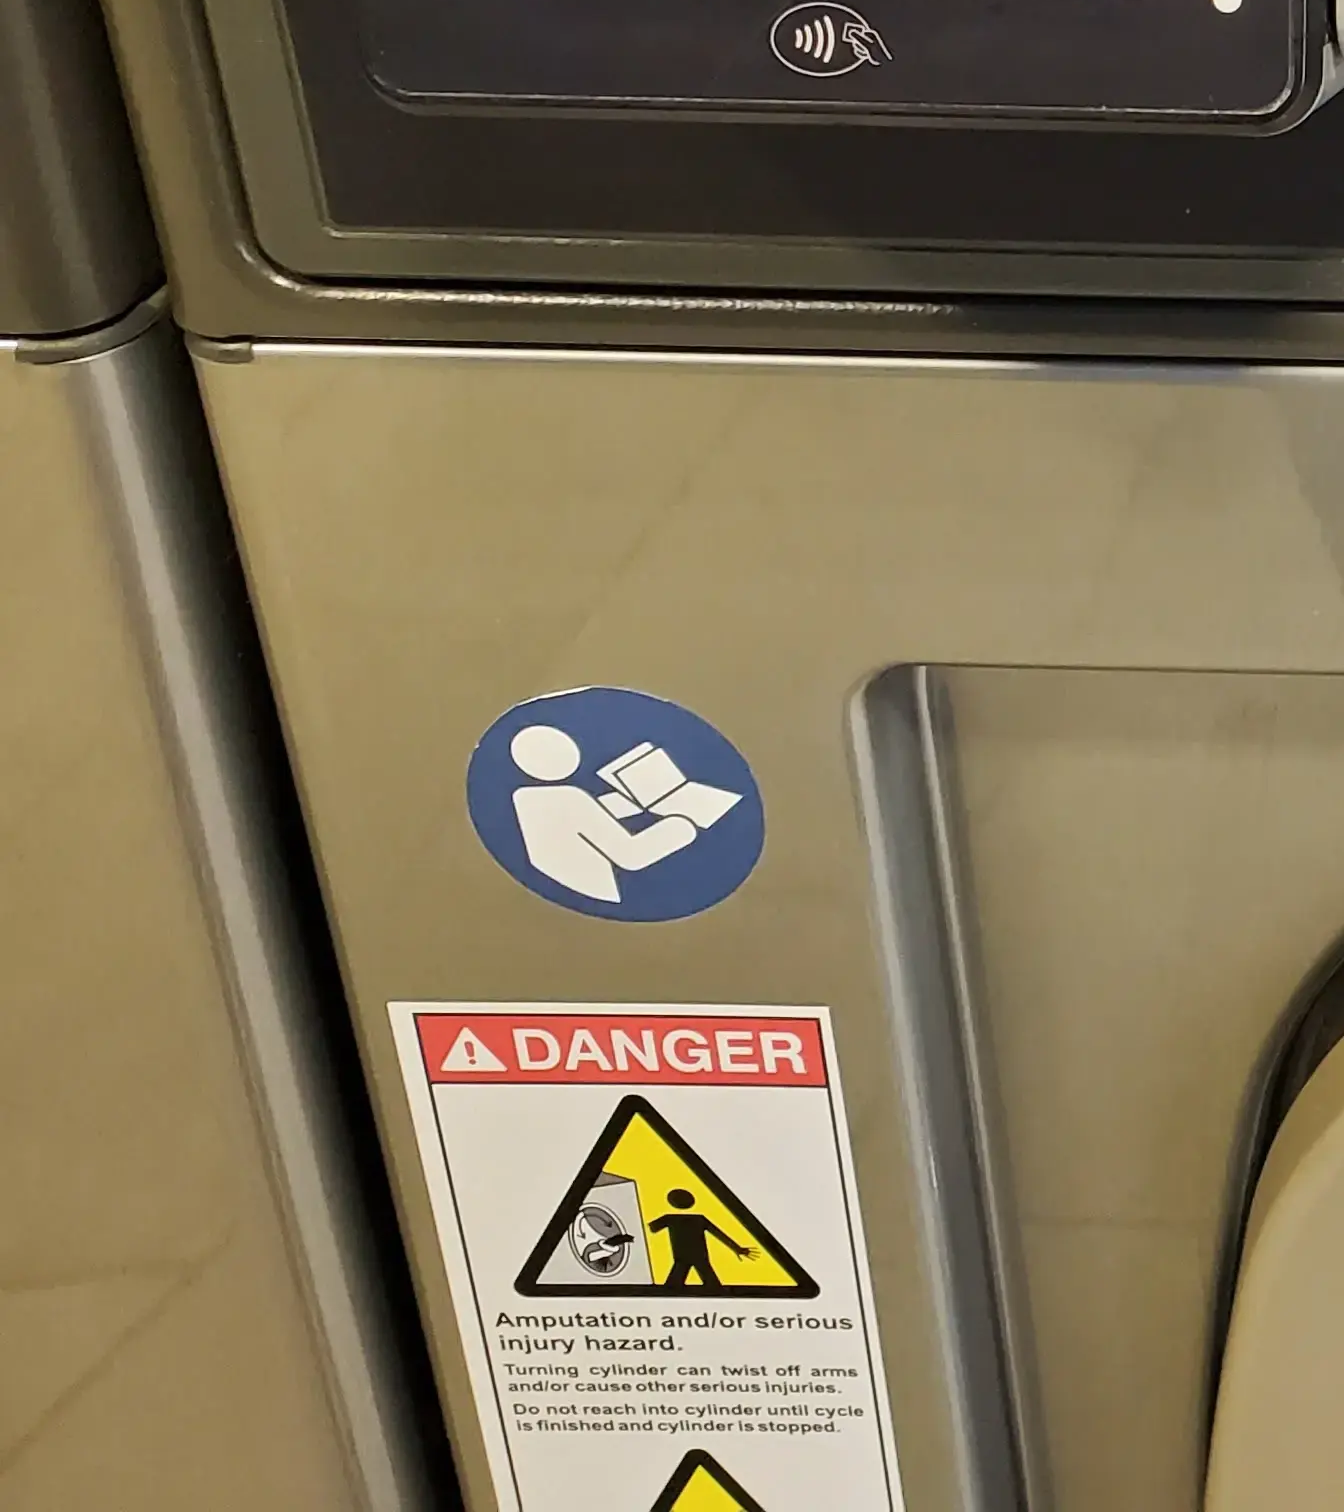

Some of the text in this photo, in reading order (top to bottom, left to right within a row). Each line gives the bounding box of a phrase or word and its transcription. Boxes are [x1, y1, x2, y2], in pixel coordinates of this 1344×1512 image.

[511, 1028, 807, 1074] DANGER
[495, 1311, 854, 1331] Amputation and/or serious
[499, 1334, 684, 1354] injury hazard.
[504, 1364, 858, 1379] Turning cylinder can twist off arms
[508, 1380, 843, 1397] and/or cause other serious injuries.
[513, 1403, 864, 1420] Do not reach into cylinder until cycle
[518, 1419, 841, 1436] is finished and cylinder is stopped.
